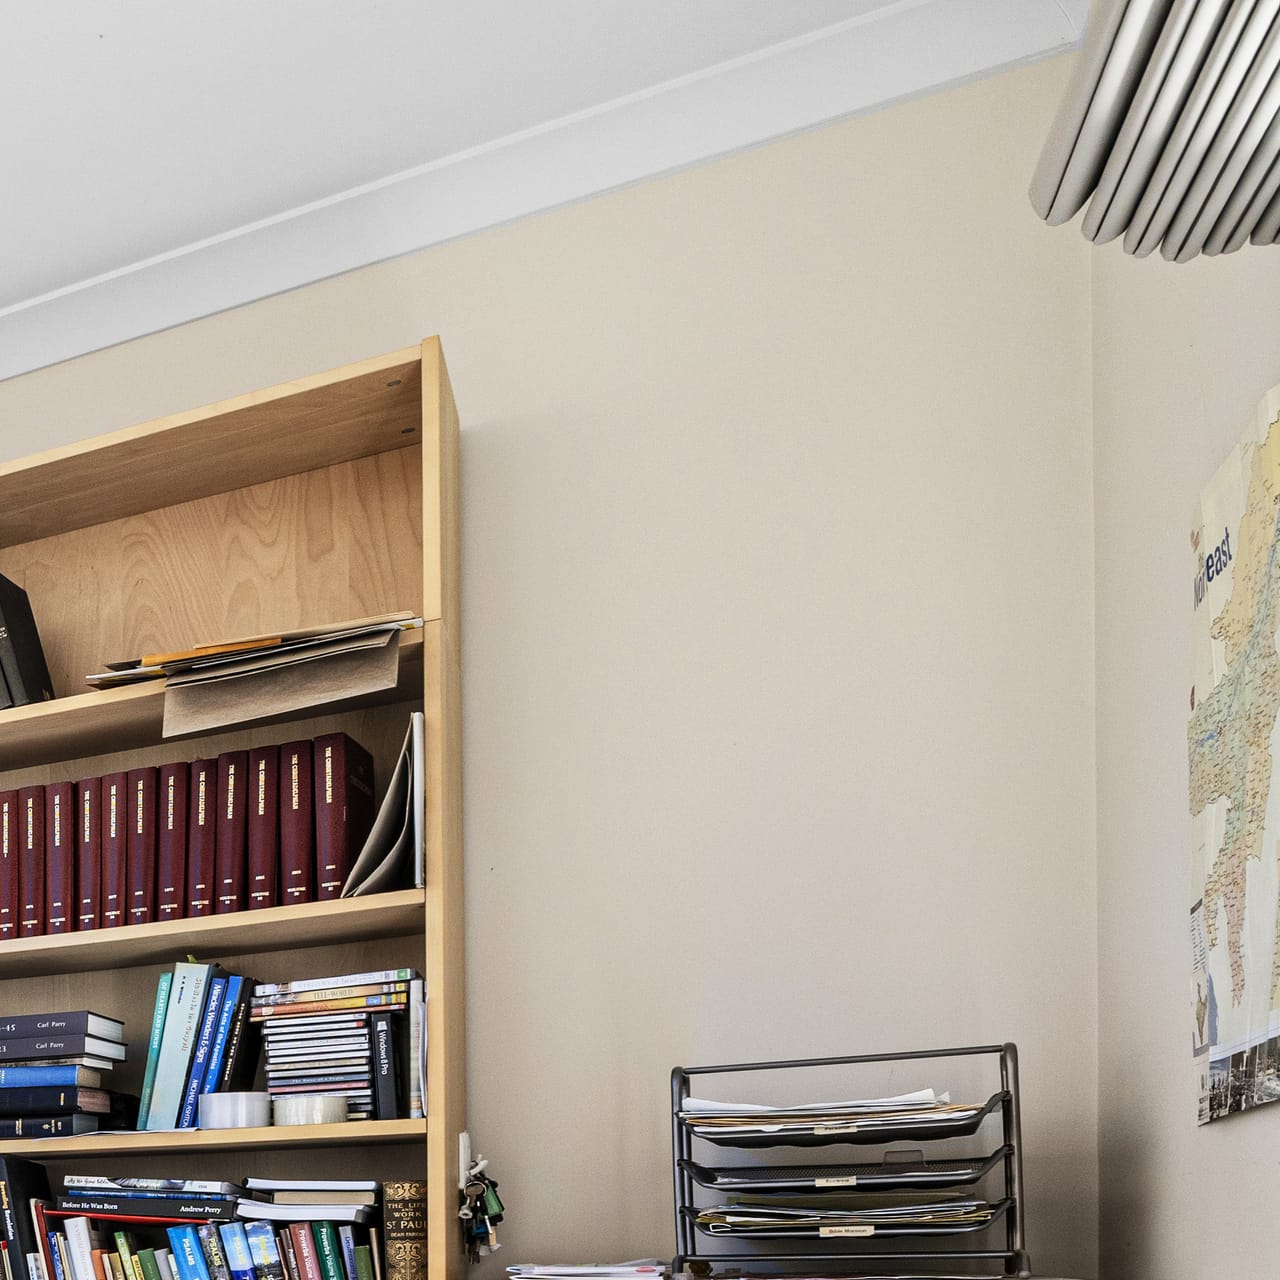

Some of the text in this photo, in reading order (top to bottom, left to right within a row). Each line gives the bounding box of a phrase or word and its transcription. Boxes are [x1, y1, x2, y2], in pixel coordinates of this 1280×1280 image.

[378, 1031, 387, 1058] Windows
[204, 1206, 222, 1214] Perry
[181, 1238, 196, 1265] PSALMS
